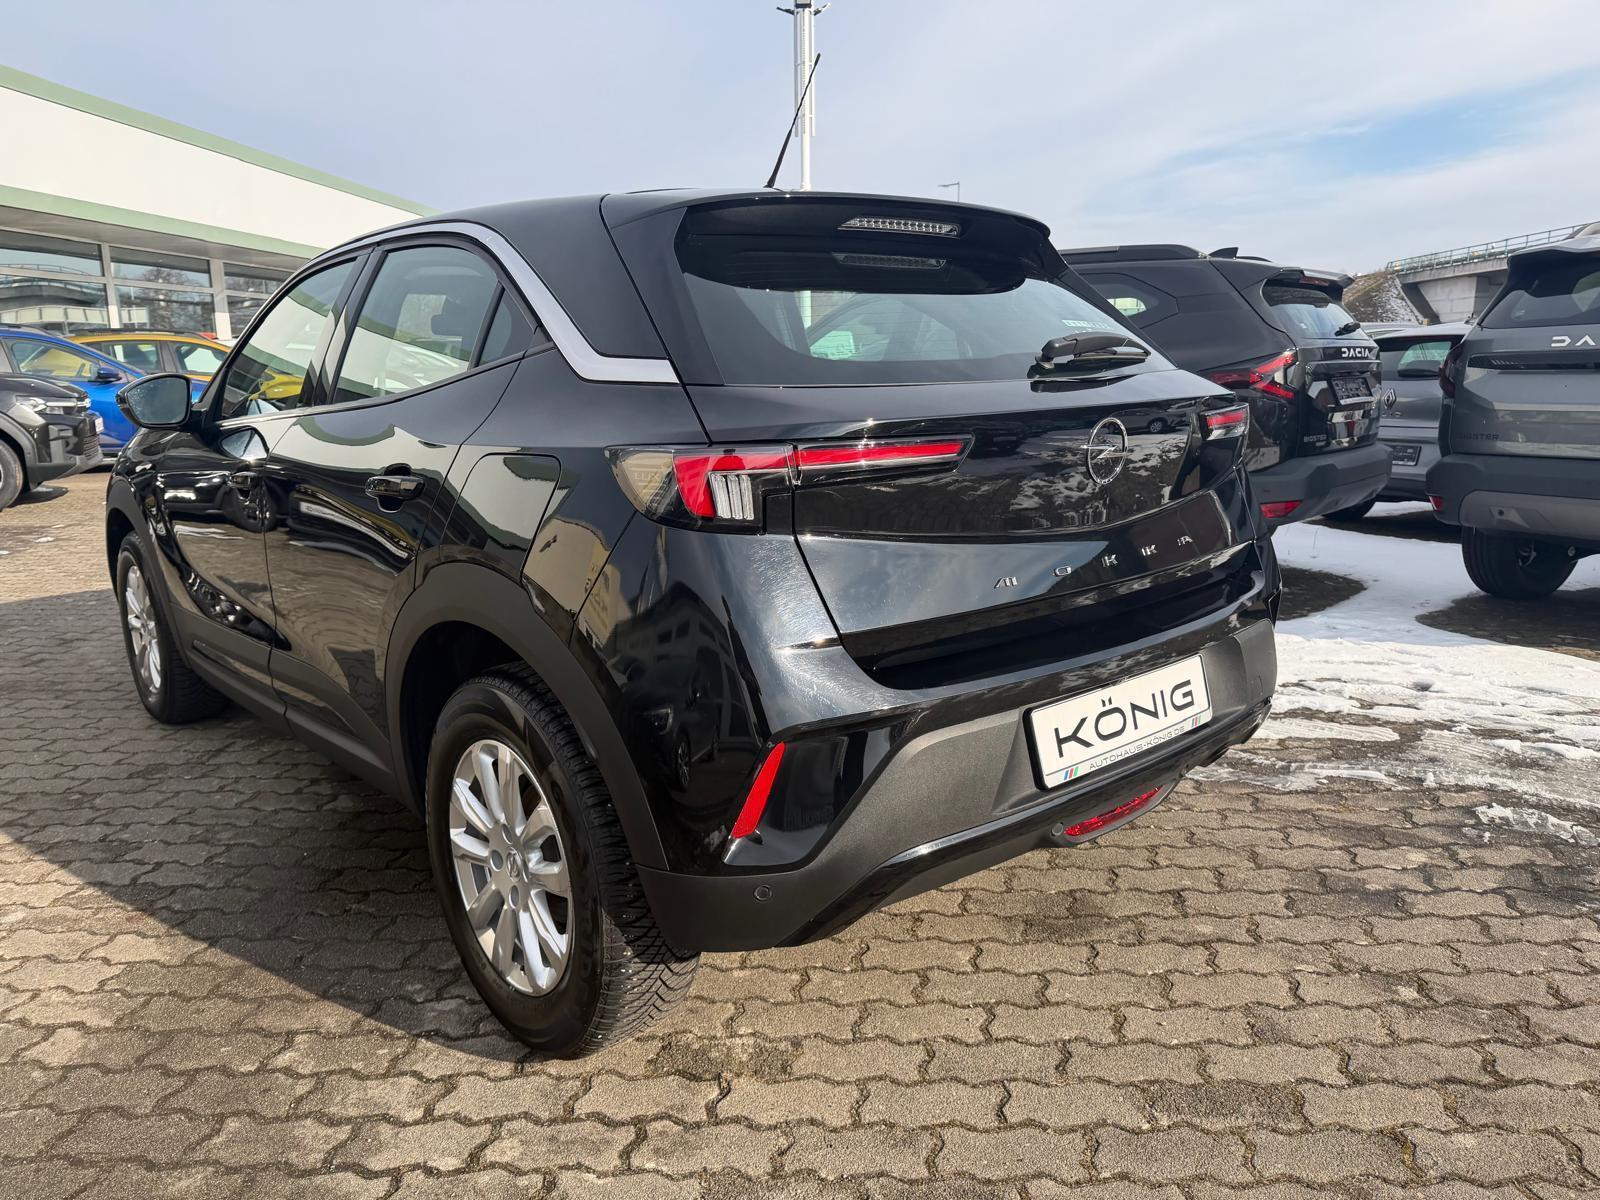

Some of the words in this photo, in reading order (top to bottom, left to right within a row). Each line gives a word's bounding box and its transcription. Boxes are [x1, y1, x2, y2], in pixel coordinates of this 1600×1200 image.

[1341, 348, 1370, 358] DACIA
[994, 535, 1192, 589] MOKKA
[1054, 679, 1195, 758] KÖNIG
